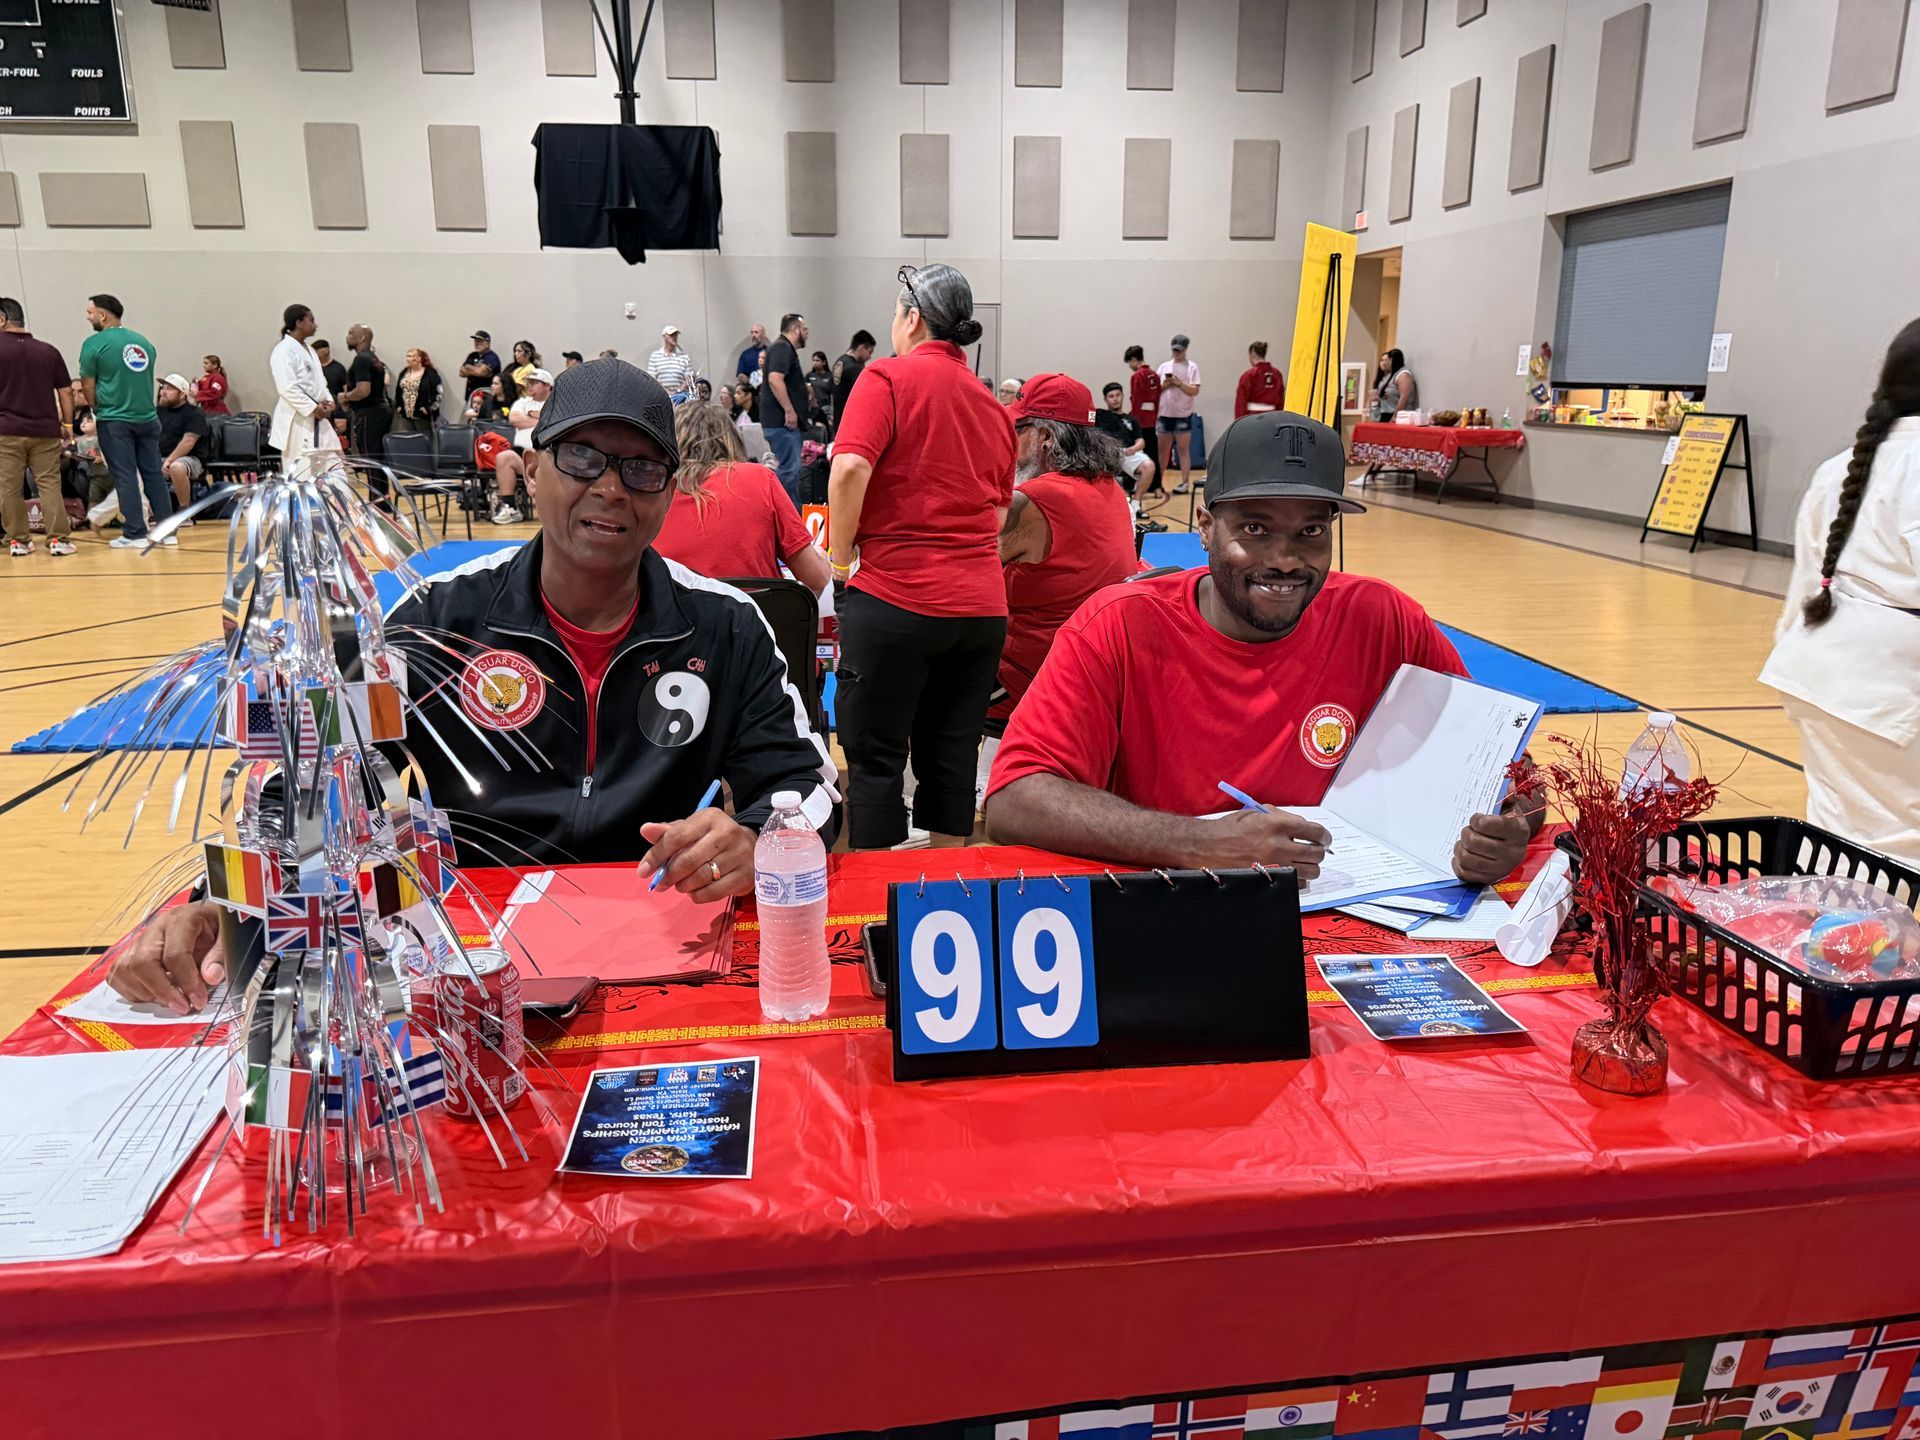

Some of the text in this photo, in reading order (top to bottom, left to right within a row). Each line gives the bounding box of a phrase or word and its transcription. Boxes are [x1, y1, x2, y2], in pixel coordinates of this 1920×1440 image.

[71, 68, 104, 78] FOULS
[74, 107, 111, 116] POINTS
[1273, 424, 1315, 468] T
[510, 660, 536, 684] DOJO
[1306, 708, 1351, 731] JAGUAR DOJO
[470, 1019, 480, 1088] OGINAL TAE
[633, 1112, 666, 1120] Texas
[689, 1116, 729, 1126] Hosted
[597, 1121, 638, 1129] Kouros
[641, 1120, 666, 1128] Toni
[582, 1123, 740, 1138] KARATE CHAMPIONSHIPS
[629, 1132, 695, 1144] KMA OPEN
